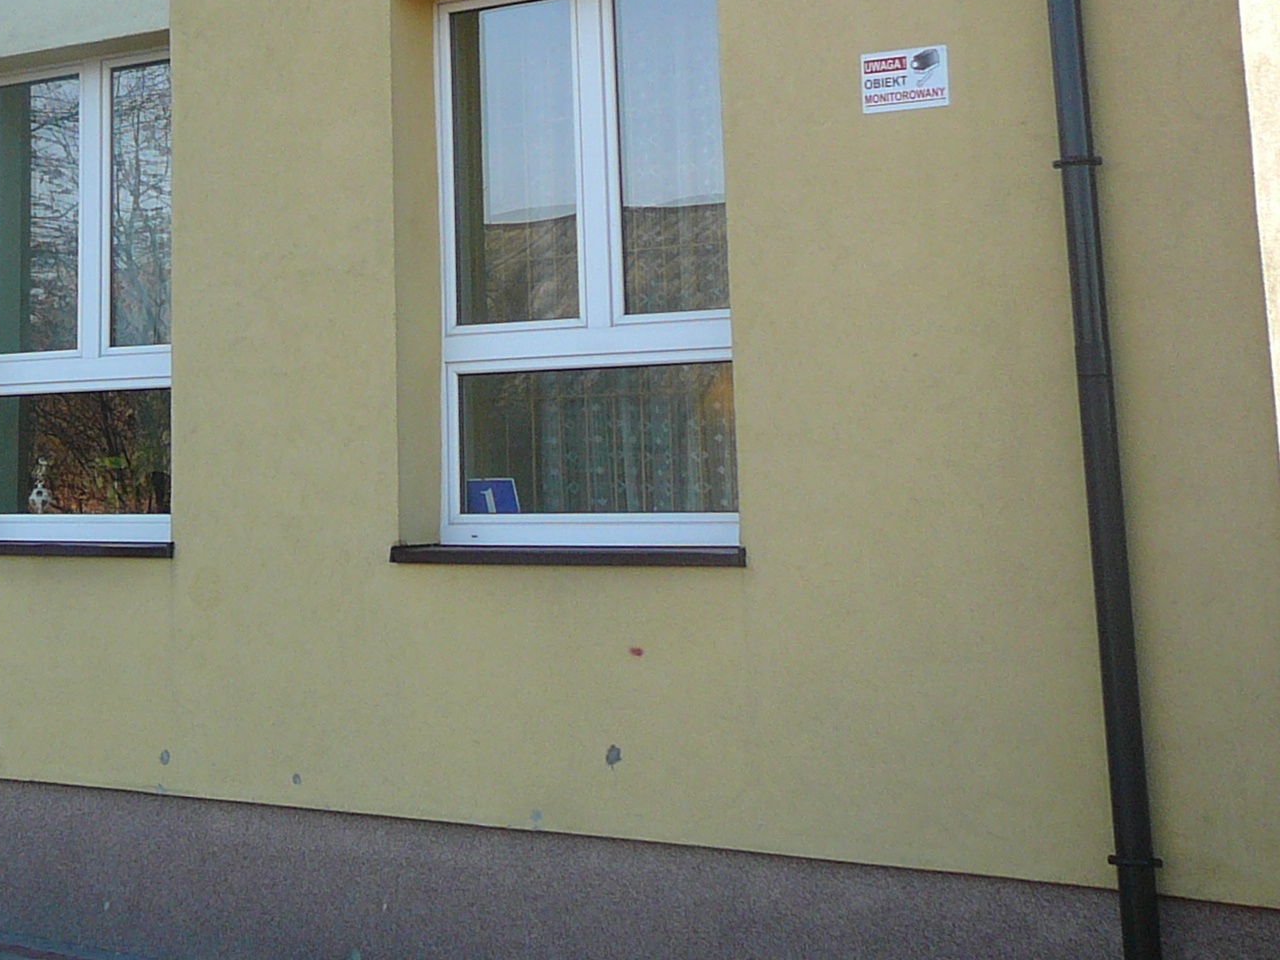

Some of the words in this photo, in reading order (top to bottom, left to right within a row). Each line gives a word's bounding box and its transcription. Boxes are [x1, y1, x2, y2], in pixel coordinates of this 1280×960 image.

[864, 59, 901, 73] UWAGA
[864, 76, 908, 90] OBIEKT
[864, 87, 946, 104] MONITOROWANY
[480, 487, 497, 513] 1
